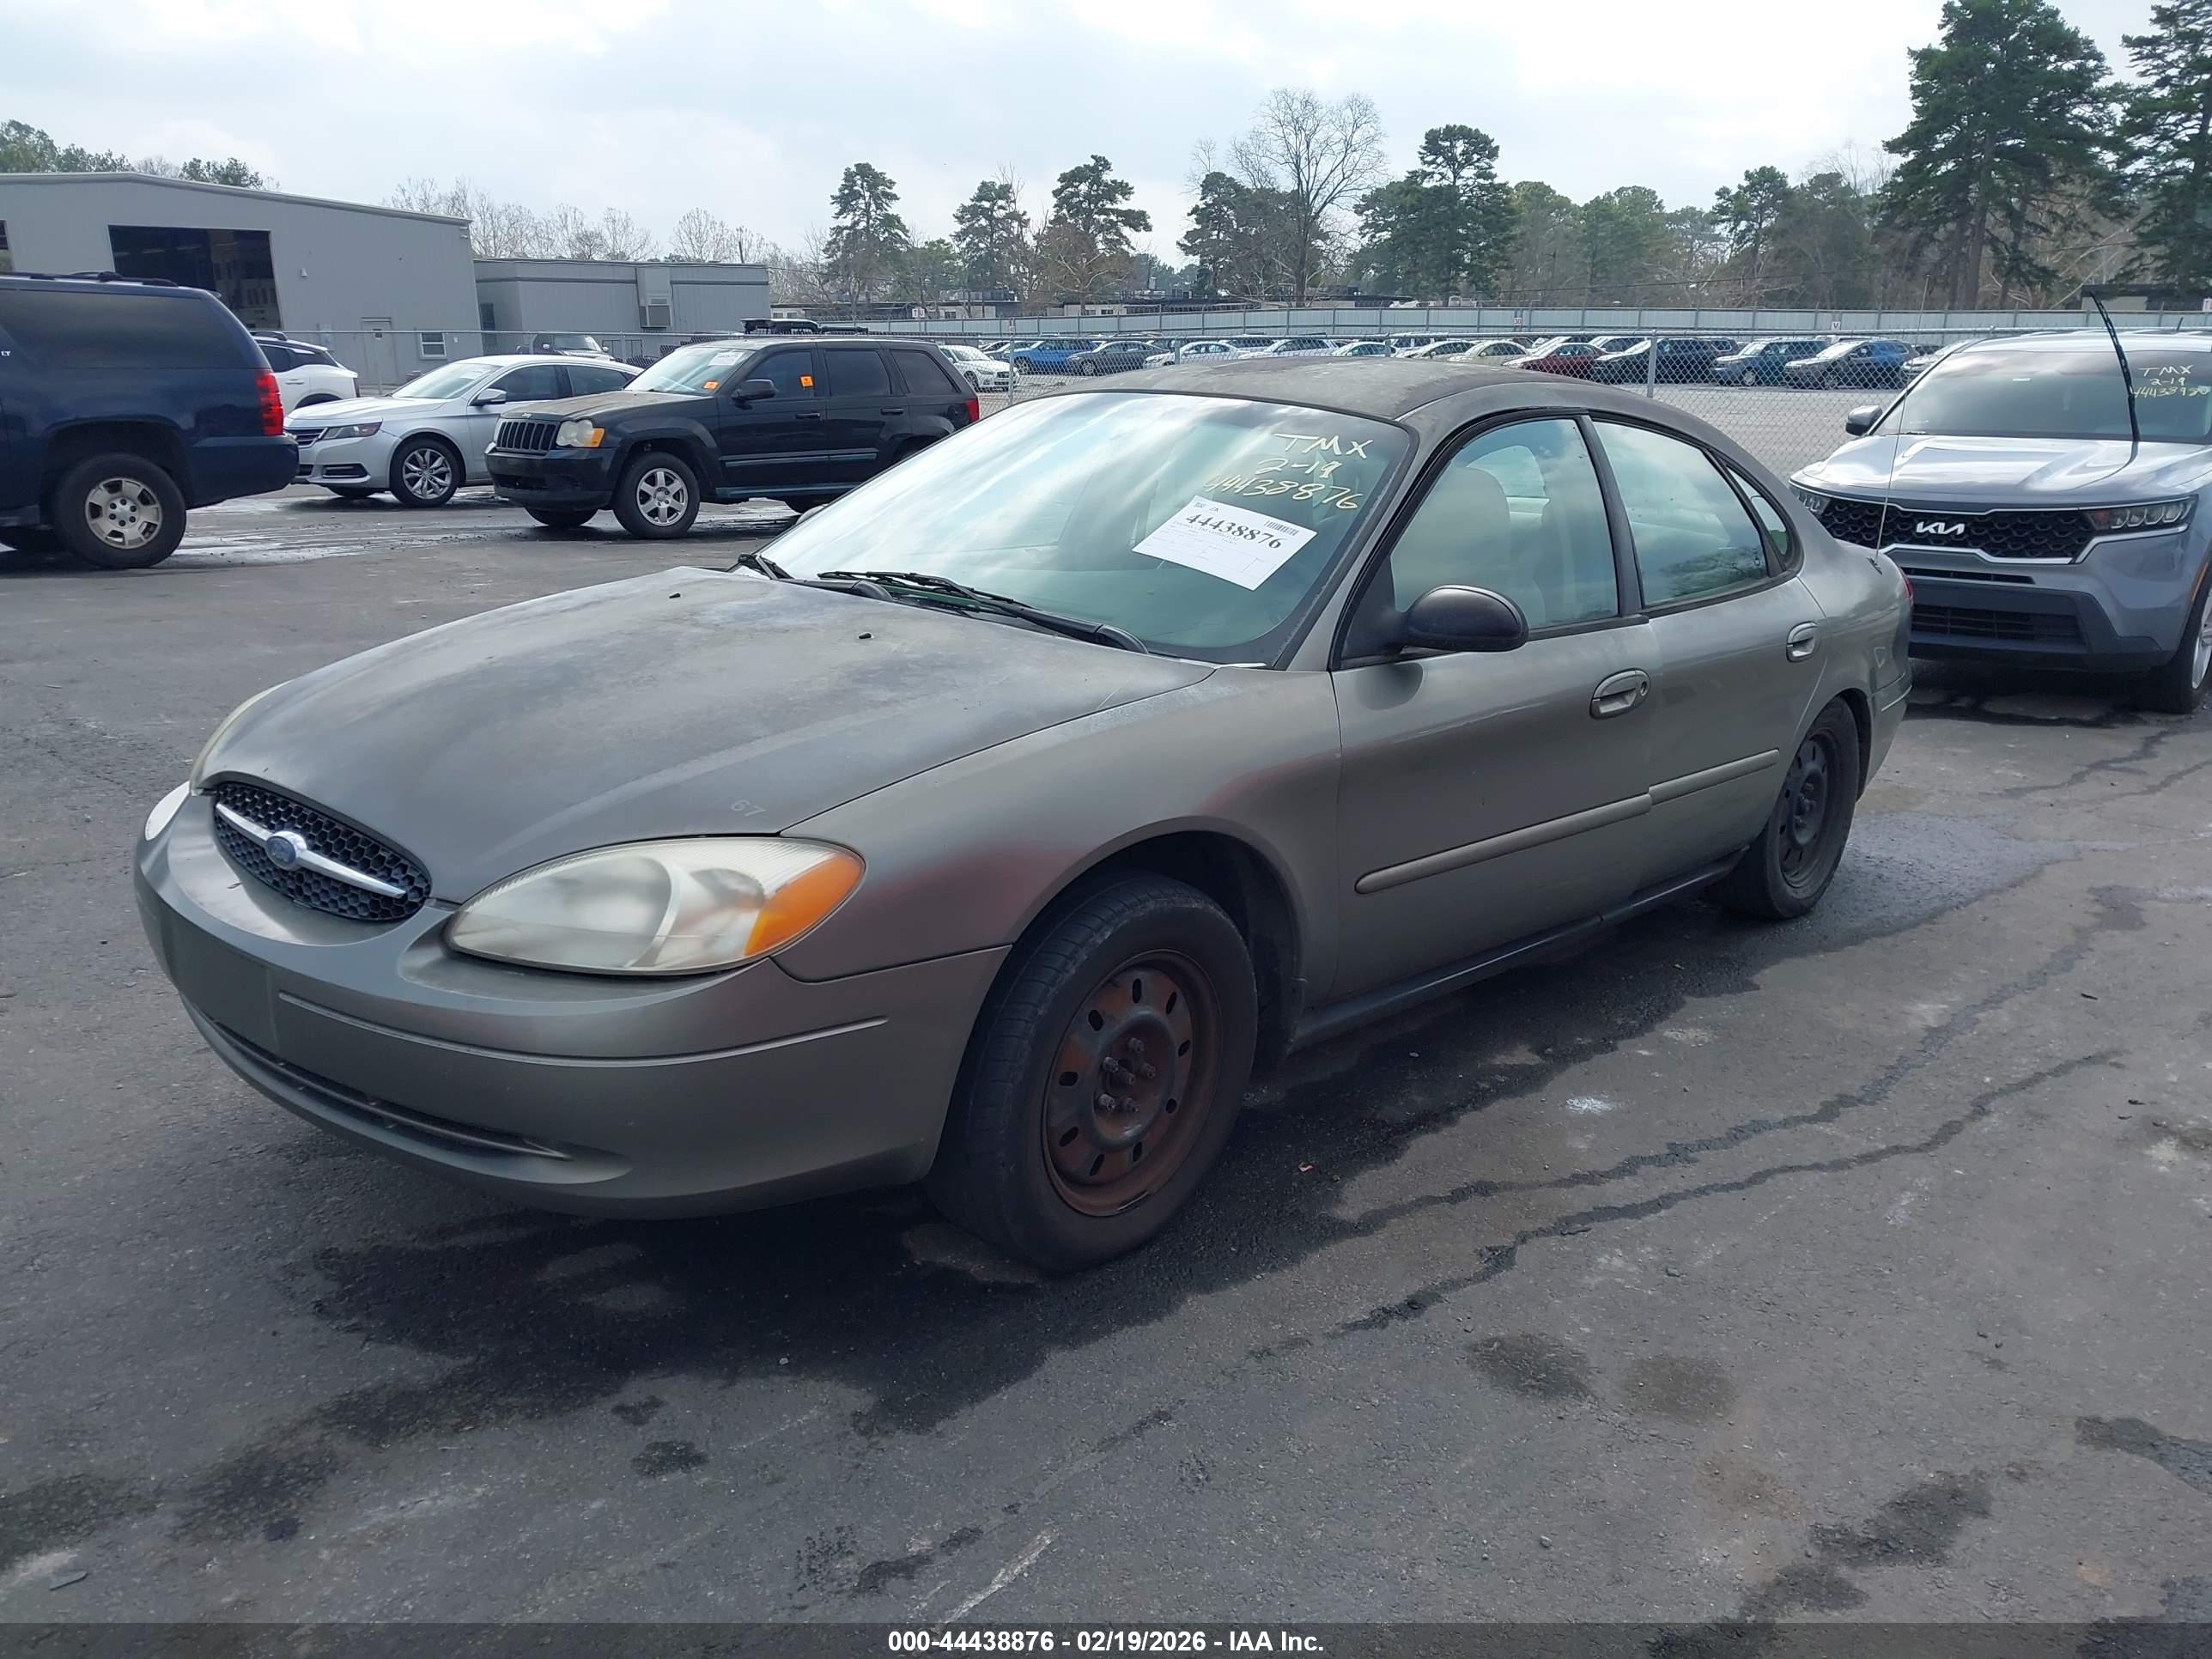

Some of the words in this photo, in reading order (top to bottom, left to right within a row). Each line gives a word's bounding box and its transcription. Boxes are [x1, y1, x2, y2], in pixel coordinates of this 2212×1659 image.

[2137, 365, 2195, 377] TMX
[2149, 377, 2186, 386] 2-19
[1273, 434, 1373, 459] TMX
[1255, 458, 1343, 478] 2-19
[1203, 473, 1364, 509] 44438876
[1185, 514, 1285, 549] 44438876
